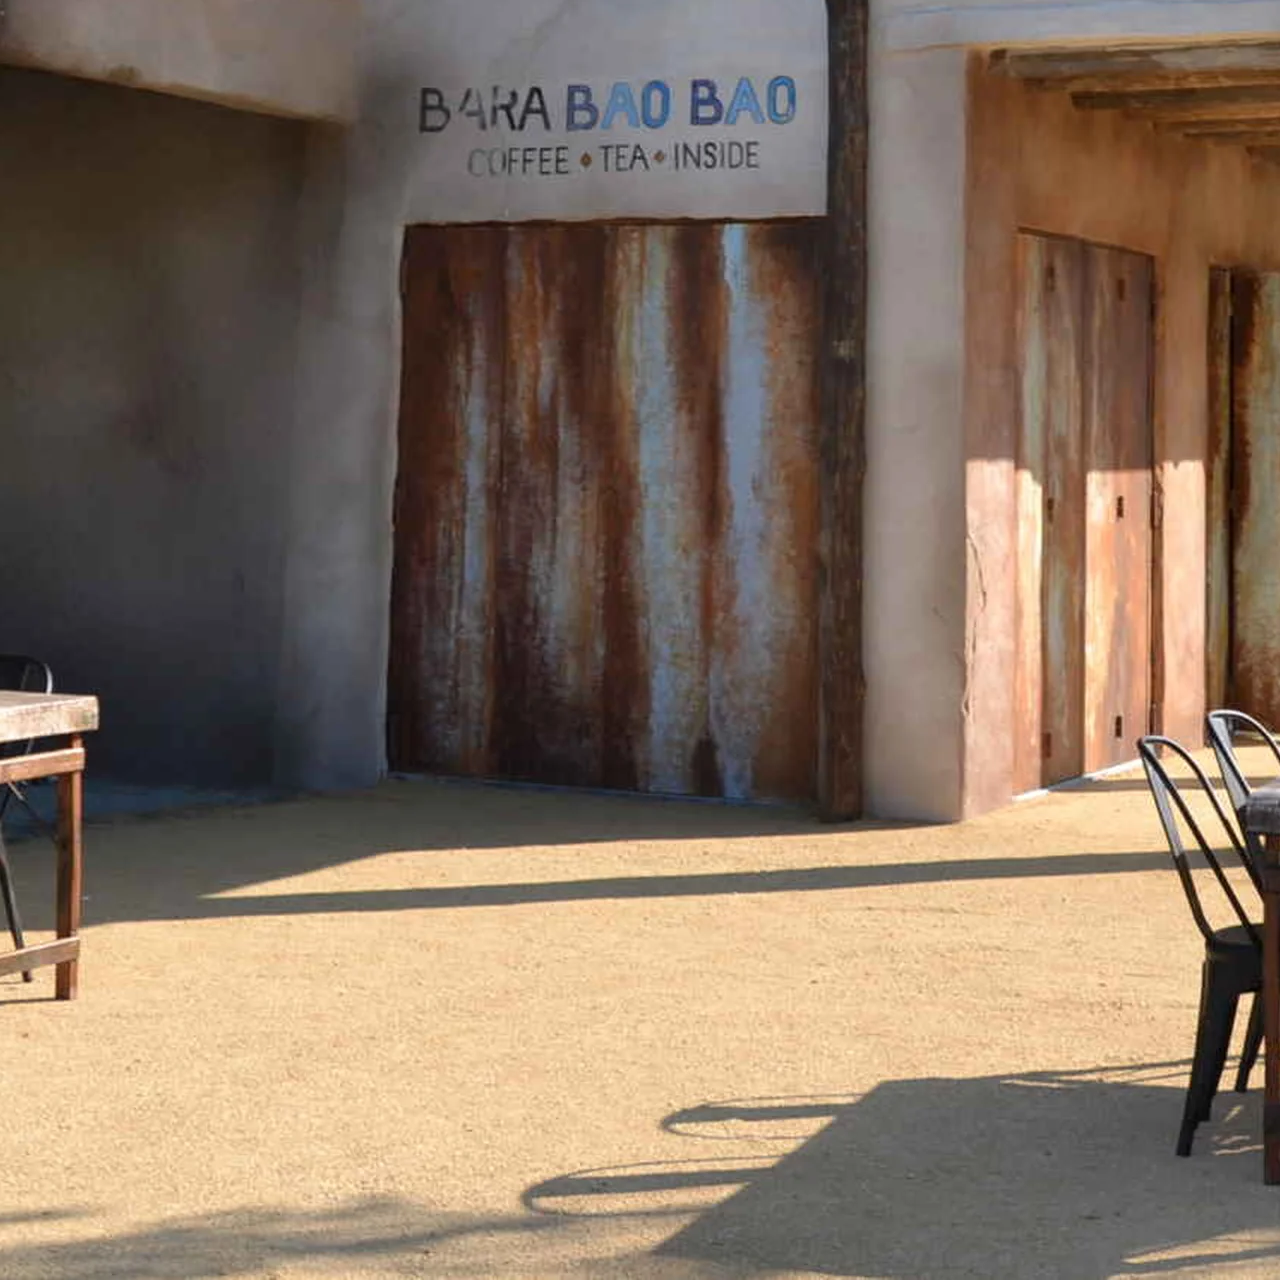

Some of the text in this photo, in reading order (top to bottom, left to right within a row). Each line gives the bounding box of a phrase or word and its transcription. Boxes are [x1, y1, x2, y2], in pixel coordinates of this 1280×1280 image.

[419, 75, 797, 132] BARA BAO BAO
[467, 141, 760, 178] COFFEE TEA INSIDE
